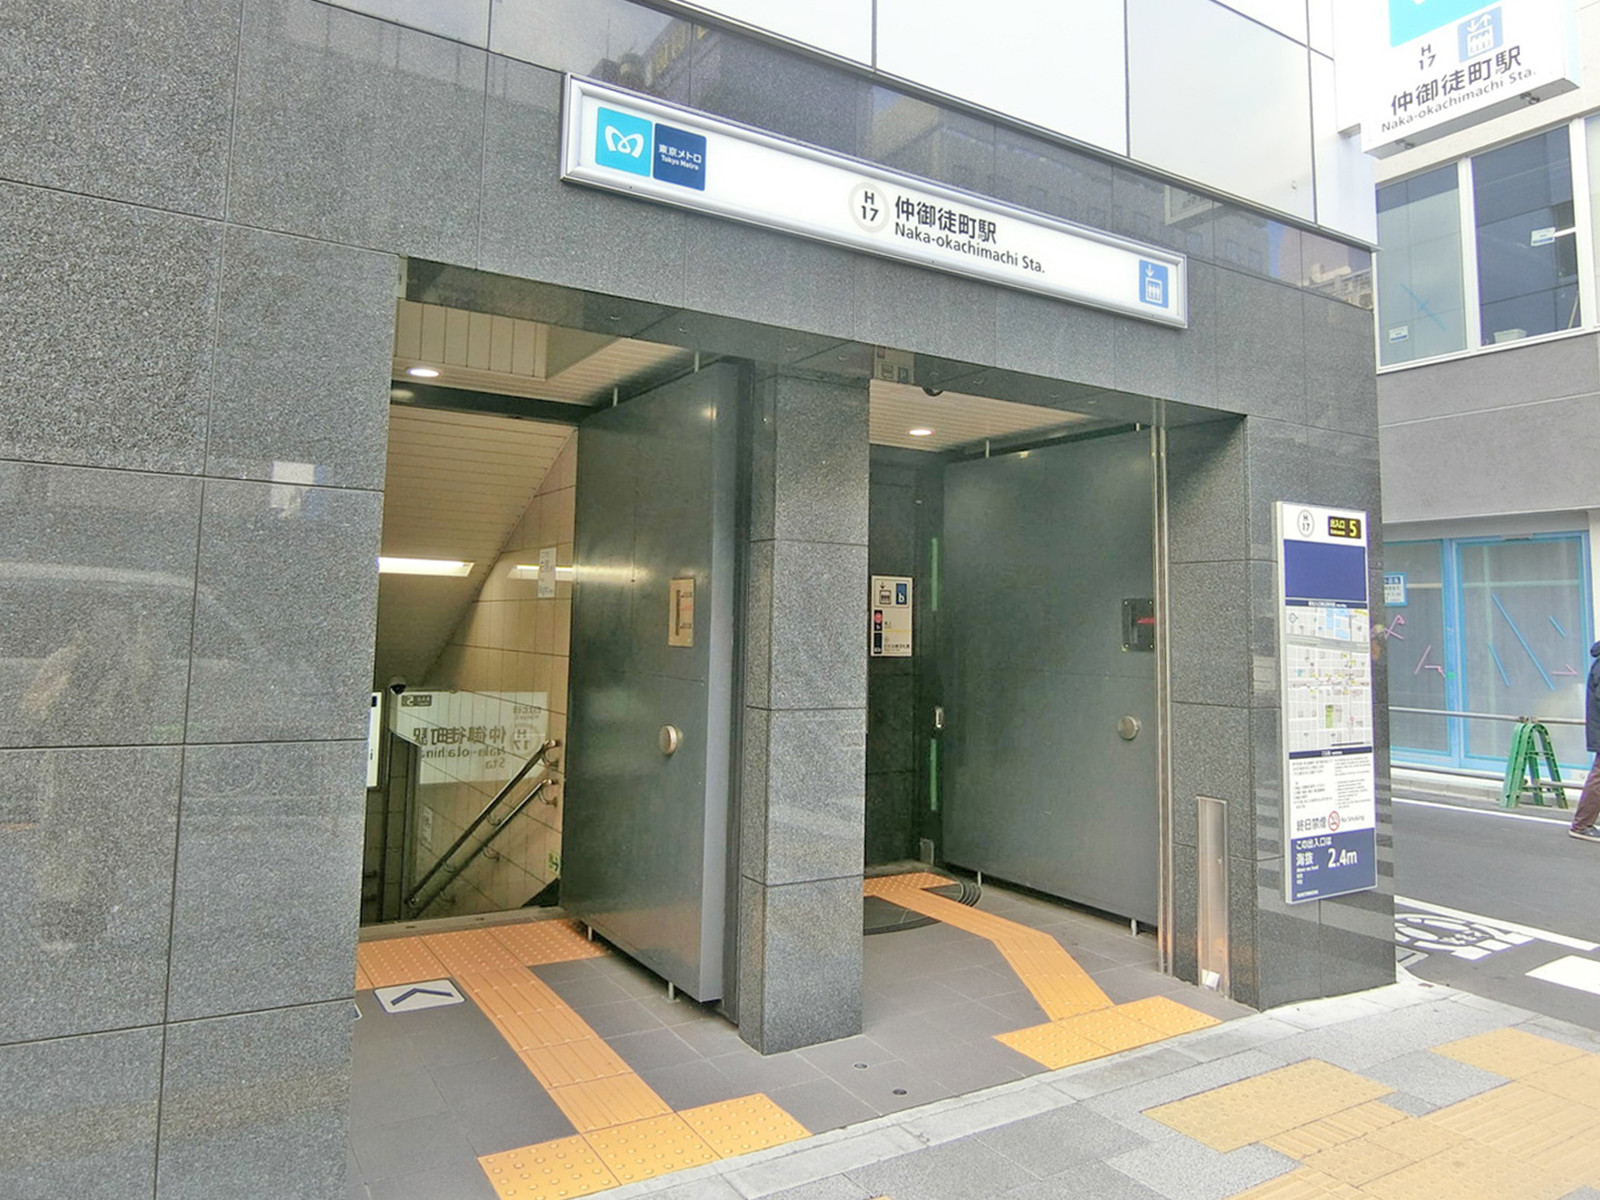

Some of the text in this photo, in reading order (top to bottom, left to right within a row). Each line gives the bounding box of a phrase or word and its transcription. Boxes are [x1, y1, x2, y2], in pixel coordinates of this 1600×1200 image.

[1421, 44, 1431, 57] H
[1418, 55, 1436, 70] 17
[1390, 45, 1522, 116] 仲御徒町駅
[1381, 67, 1536, 133] Naka-okachimachi Sta.
[659, 144, 702, 163] 東京メトロ
[661, 154, 699, 170] Tokyo Metro
[864, 190, 875, 205] H
[861, 205, 879, 222] 17
[895, 195, 997, 244] 仲御徒町駅
[895, 222, 1045, 273] Naka-okachimachi Sta.
[1349, 520, 1357, 537] 5
[1296, 836, 1332, 850] この出入口は
[1327, 847, 1358, 868] 2.4m
